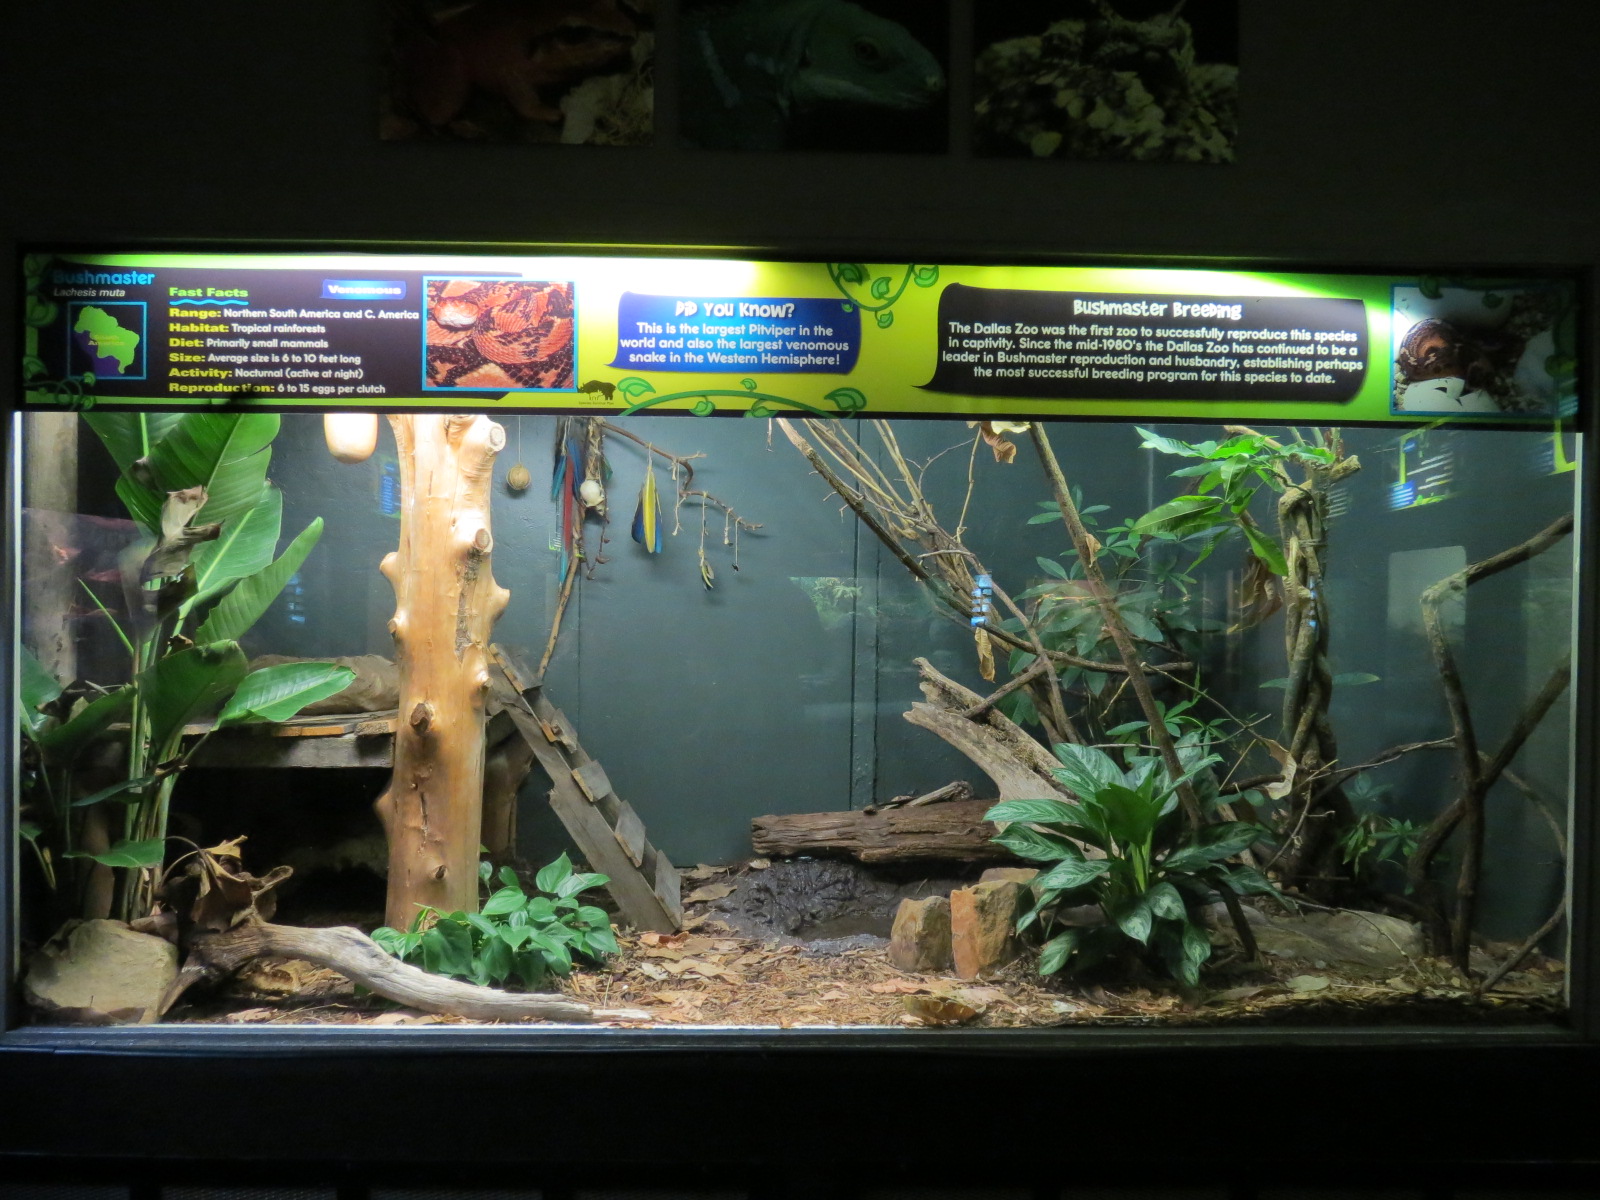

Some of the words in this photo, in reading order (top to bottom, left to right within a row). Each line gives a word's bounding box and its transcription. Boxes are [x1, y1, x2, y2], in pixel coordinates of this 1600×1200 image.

[53, 270, 155, 285] Bushmaster
[54, 287, 96, 297] Lachesis
[99, 289, 125, 297] muta
[169, 287, 202, 297] Fast
[206, 287, 248, 297] Facts
[169, 308, 221, 319] Range:
[223, 308, 267, 318] Northern
[269, 308, 297, 318] South
[299, 309, 341, 318] America
[343, 310, 362, 319] and
[364, 310, 376, 319] C.
[378, 310, 419, 319] America
[739, 303, 795, 318] Know?
[1073, 299, 1168, 316] Bushmaster
[169, 323, 229, 332] Habitat:
[231, 324, 271, 334] Tropical
[273, 324, 326, 333] rainforests
[636, 322, 663, 334] This
[666, 322, 676, 334] is
[679, 323, 699, 334] the
[703, 323, 746, 337] largest
[749, 324, 796, 338] Pitviper
[799, 325, 810, 336] in
[813, 325, 834, 336] the
[949, 322, 971, 333] The
[974, 323, 1012, 334] Dallas
[1015, 323, 1039, 335] Zoo
[1041, 326, 1065, 335] was
[1068, 325, 1087, 336] the
[1090, 325, 1114, 336] first
[1116, 327, 1138, 337] zoo
[1141, 326, 1153, 337] to
[1155, 327, 1224, 341] successfully
[1227, 328, 1288, 342] reproduce
[1290, 329, 1312, 340] this
[1314, 330, 1358, 343] species
[169, 338, 204, 347] Diet:
[206, 338, 250, 349] Primarily
[252, 339, 278, 348] small
[280, 339, 328, 348] mammals
[620, 337, 655, 348] world
[658, 337, 684, 348] and
[687, 338, 714, 349] also
[716, 339, 737, 349] the
[740, 339, 783, 352] largest
[785, 341, 849, 351] venomous
[948, 337, 959, 348] in
[962, 337, 1016, 351] captivity.
[1019, 338, 1051, 349] Since
[1054, 339, 1073, 350] the
[1075, 339, 1142, 351] mid-1980's
[1145, 341, 1164, 351] the
[1166, 341, 1204, 353] Dallas
[1206, 342, 1230, 353] Zoo
[1232, 342, 1254, 354] has
[1256, 343, 1314, 355] continued
[1317, 344, 1329, 355] to
[1331, 344, 1347, 355] be
[1349, 347, 1358, 356] a
[169, 353, 205, 362] Size:
[208, 353, 248, 364] Average
[251, 353, 269, 362] size
[271, 353, 279, 362] is
[282, 354, 289, 362] 6
[291, 354, 302, 363] to
[304, 354, 316, 363] 10
[319, 354, 338, 363] feet
[340, 354, 361, 365] long
[629, 352, 666, 363] snake
[670, 352, 681, 363] in
[684, 352, 704, 363] the
[707, 352, 758, 364] Western
[761, 353, 840, 367] Hemisphere!
[942, 351, 980, 362] leader
[983, 352, 994, 362] in
[997, 352, 1067, 364] Bushmaster
[1070, 354, 1146, 367] reproduction
[1148, 355, 1172, 366] and
[1175, 355, 1240, 369] husbandry,
[1243, 357, 1313, 371] establishing
[1315, 359, 1363, 372] perhaps
[169, 368, 232, 379] Activity:
[235, 368, 282, 378] Nocturnal
[285, 368, 319, 379] (active
[321, 369, 332, 378] at
[334, 368, 363, 380] night)
[973, 366, 993, 377] the
[995, 367, 1025, 377] most
[1028, 367, 1089, 379] successful
[1092, 368, 1144, 382] breeding
[1147, 371, 1198, 382] program
[1200, 370, 1217, 381] for
[1220, 371, 1241, 382] this
[1244, 371, 1288, 384] species
[1290, 372, 1302, 383] to
[1305, 372, 1336, 384] date.
[169, 383, 275, 394] Reproduction:
[277, 384, 284, 392] 6
[287, 384, 297, 392] to
[299, 384, 310, 393] 15
[312, 386, 335, 395] eggs
[337, 386, 354, 395] per
[356, 385, 385, 394] clutch
